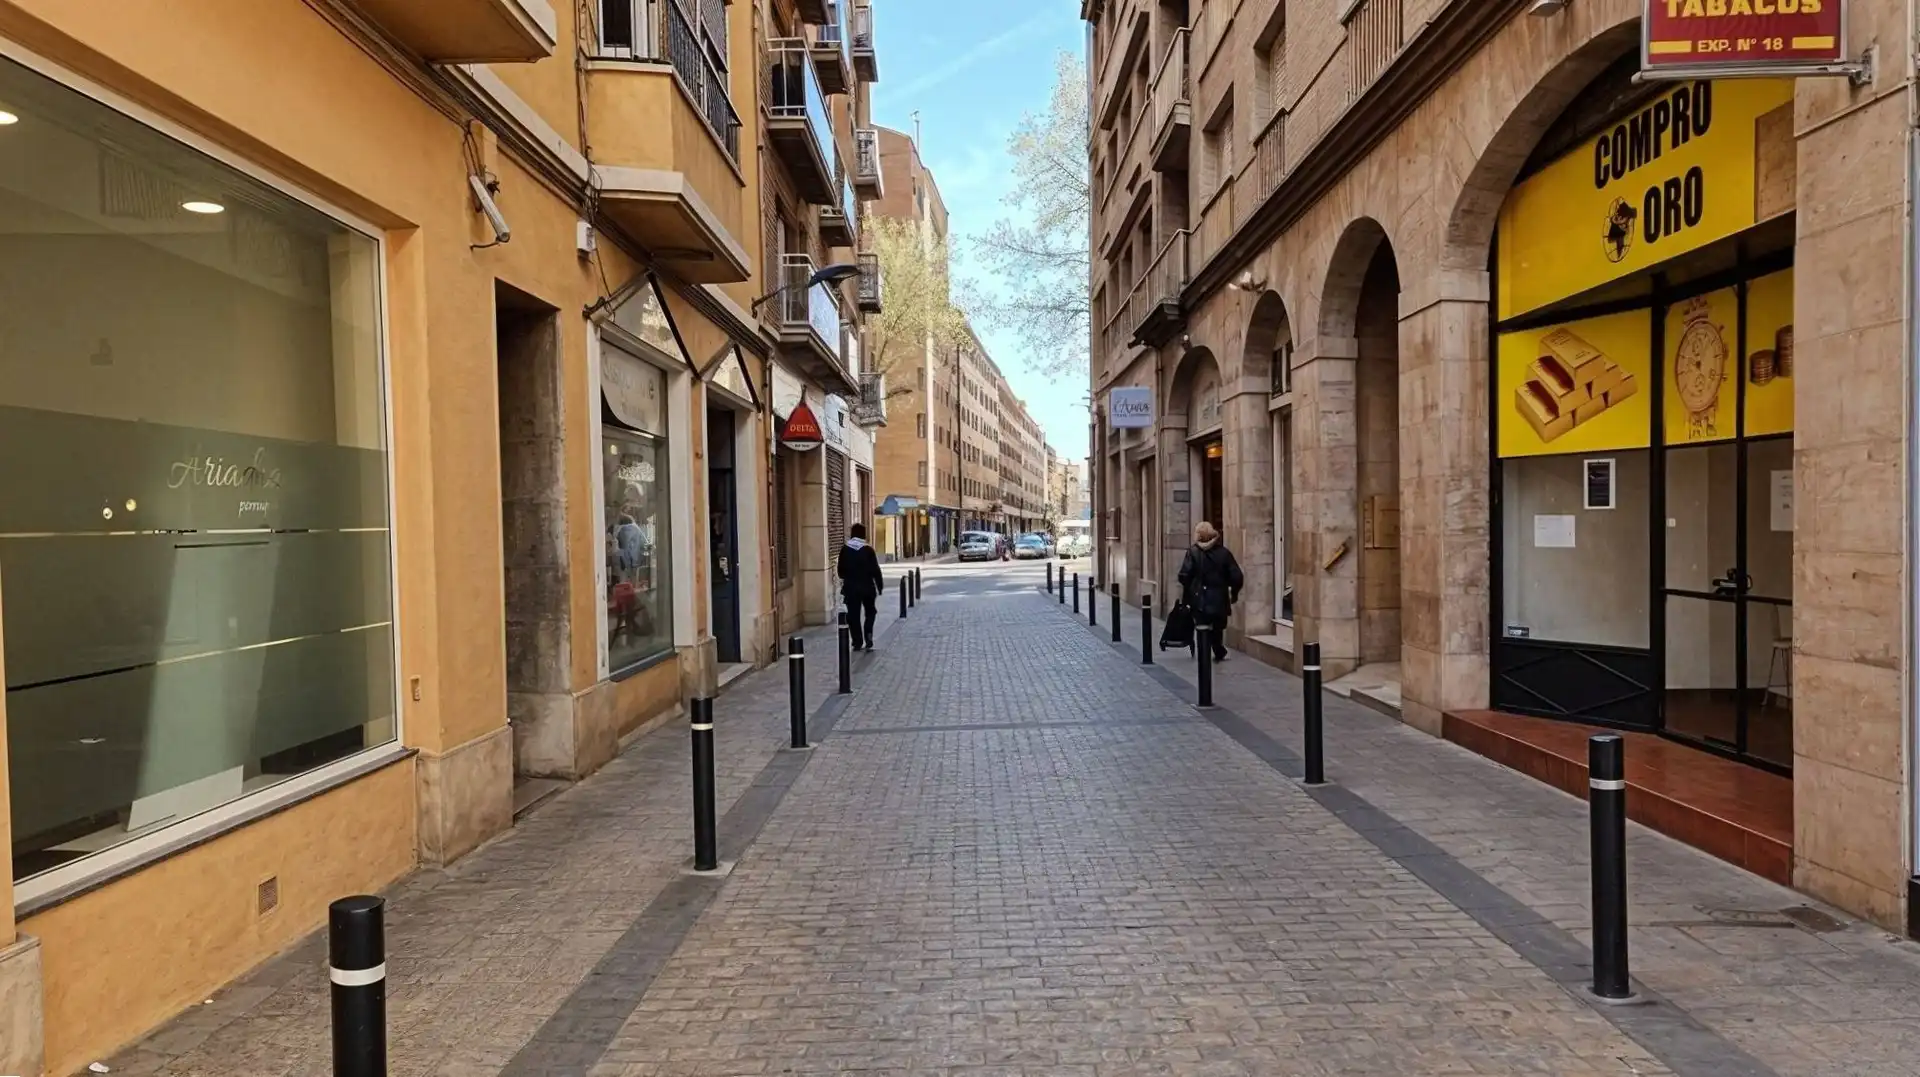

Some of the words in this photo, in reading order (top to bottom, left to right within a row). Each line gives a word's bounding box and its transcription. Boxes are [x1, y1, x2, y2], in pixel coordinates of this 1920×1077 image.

[1697, 39, 1732, 53] EXP.
[1762, 37, 1784, 50] 18
[1594, 80, 1712, 190] COMPRO
[1643, 166, 1703, 244] ORO
[790, 424, 815, 433] DELTA
